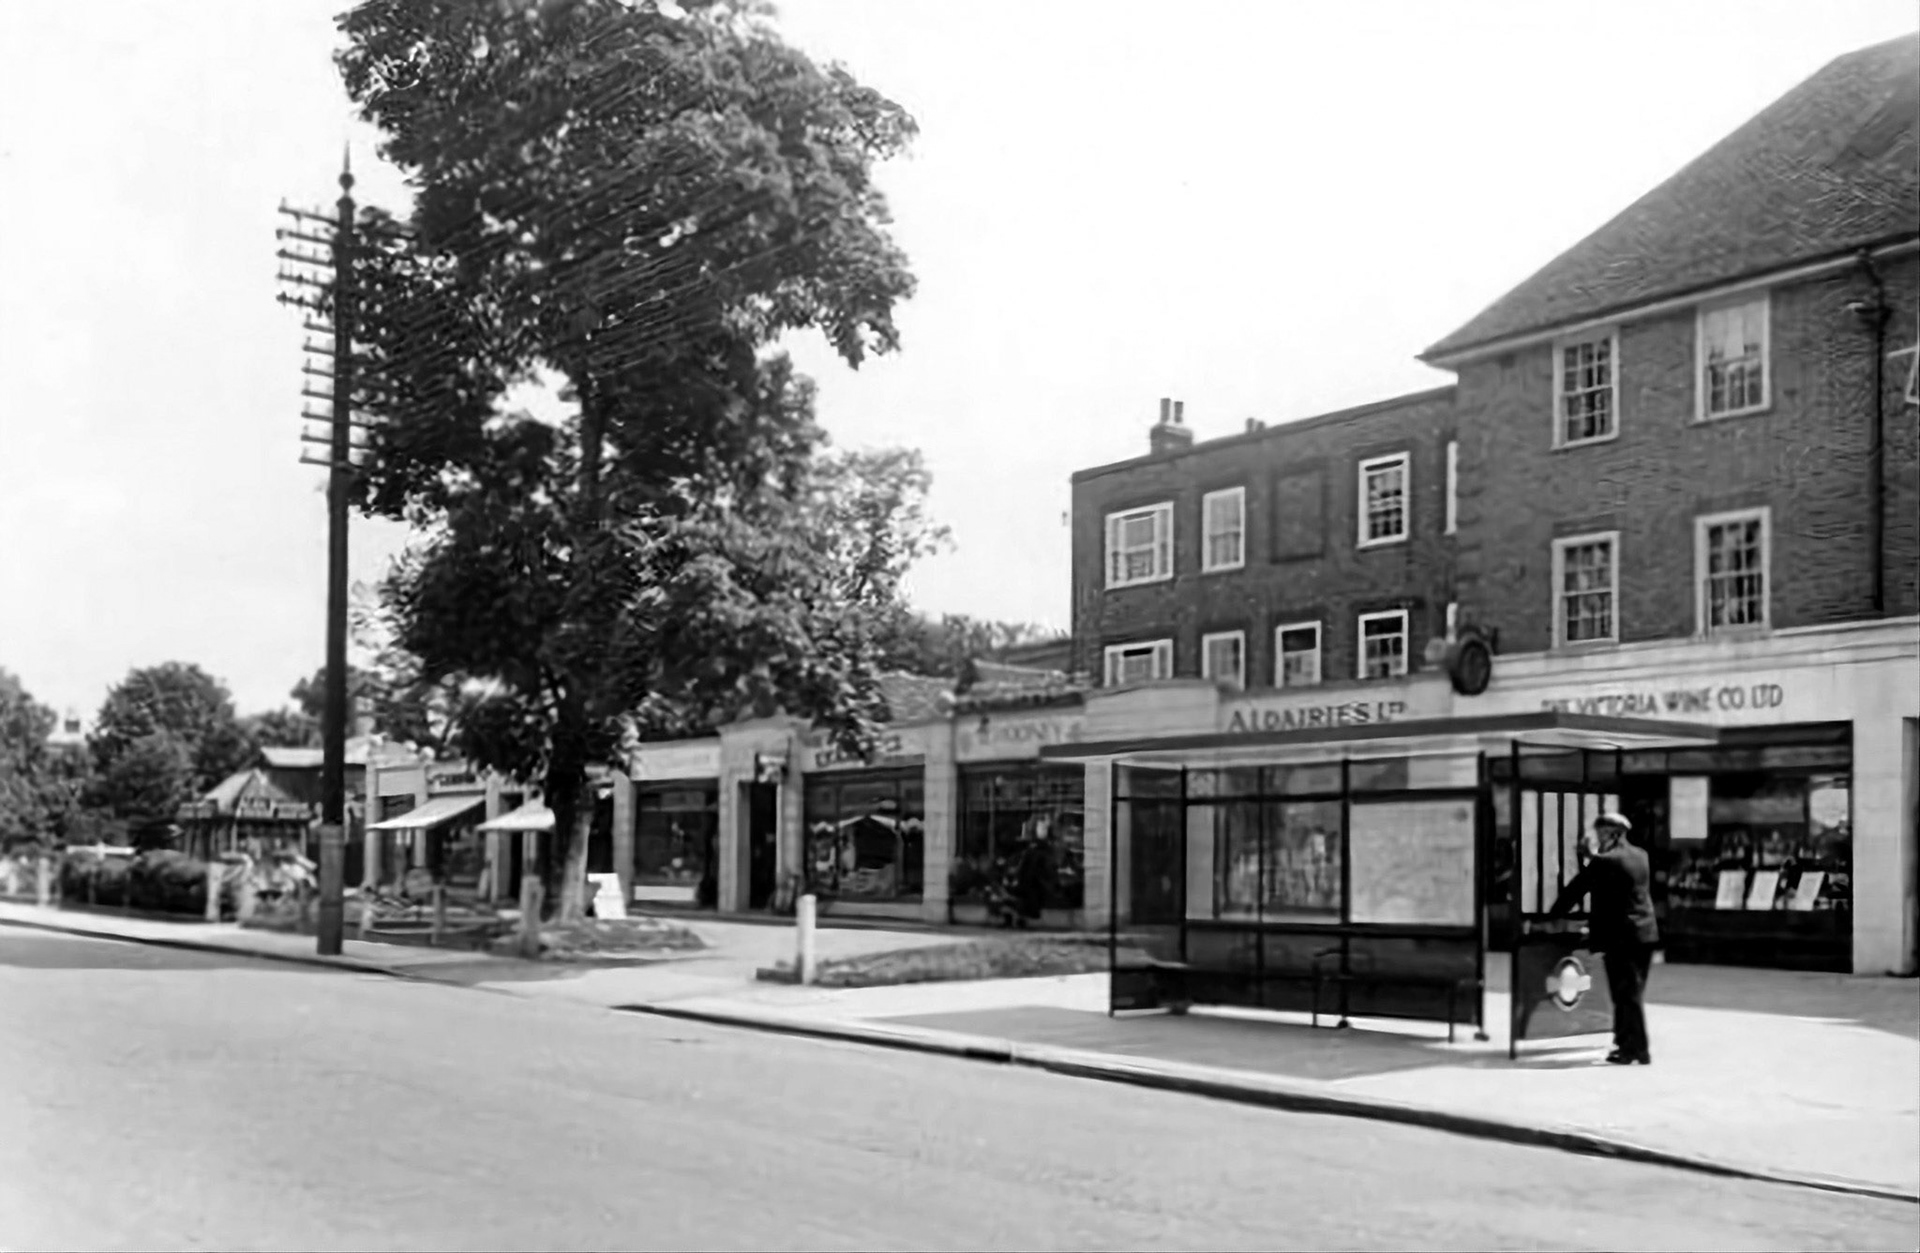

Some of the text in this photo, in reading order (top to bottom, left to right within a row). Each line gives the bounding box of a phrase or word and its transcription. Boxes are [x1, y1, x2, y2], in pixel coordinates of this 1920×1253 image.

[1572, 693, 1658, 715] VICTORIA
[1662, 687, 1711, 713] WINE
[1716, 686, 1746, 711] CO
[1751, 684, 1784, 710] LTD
